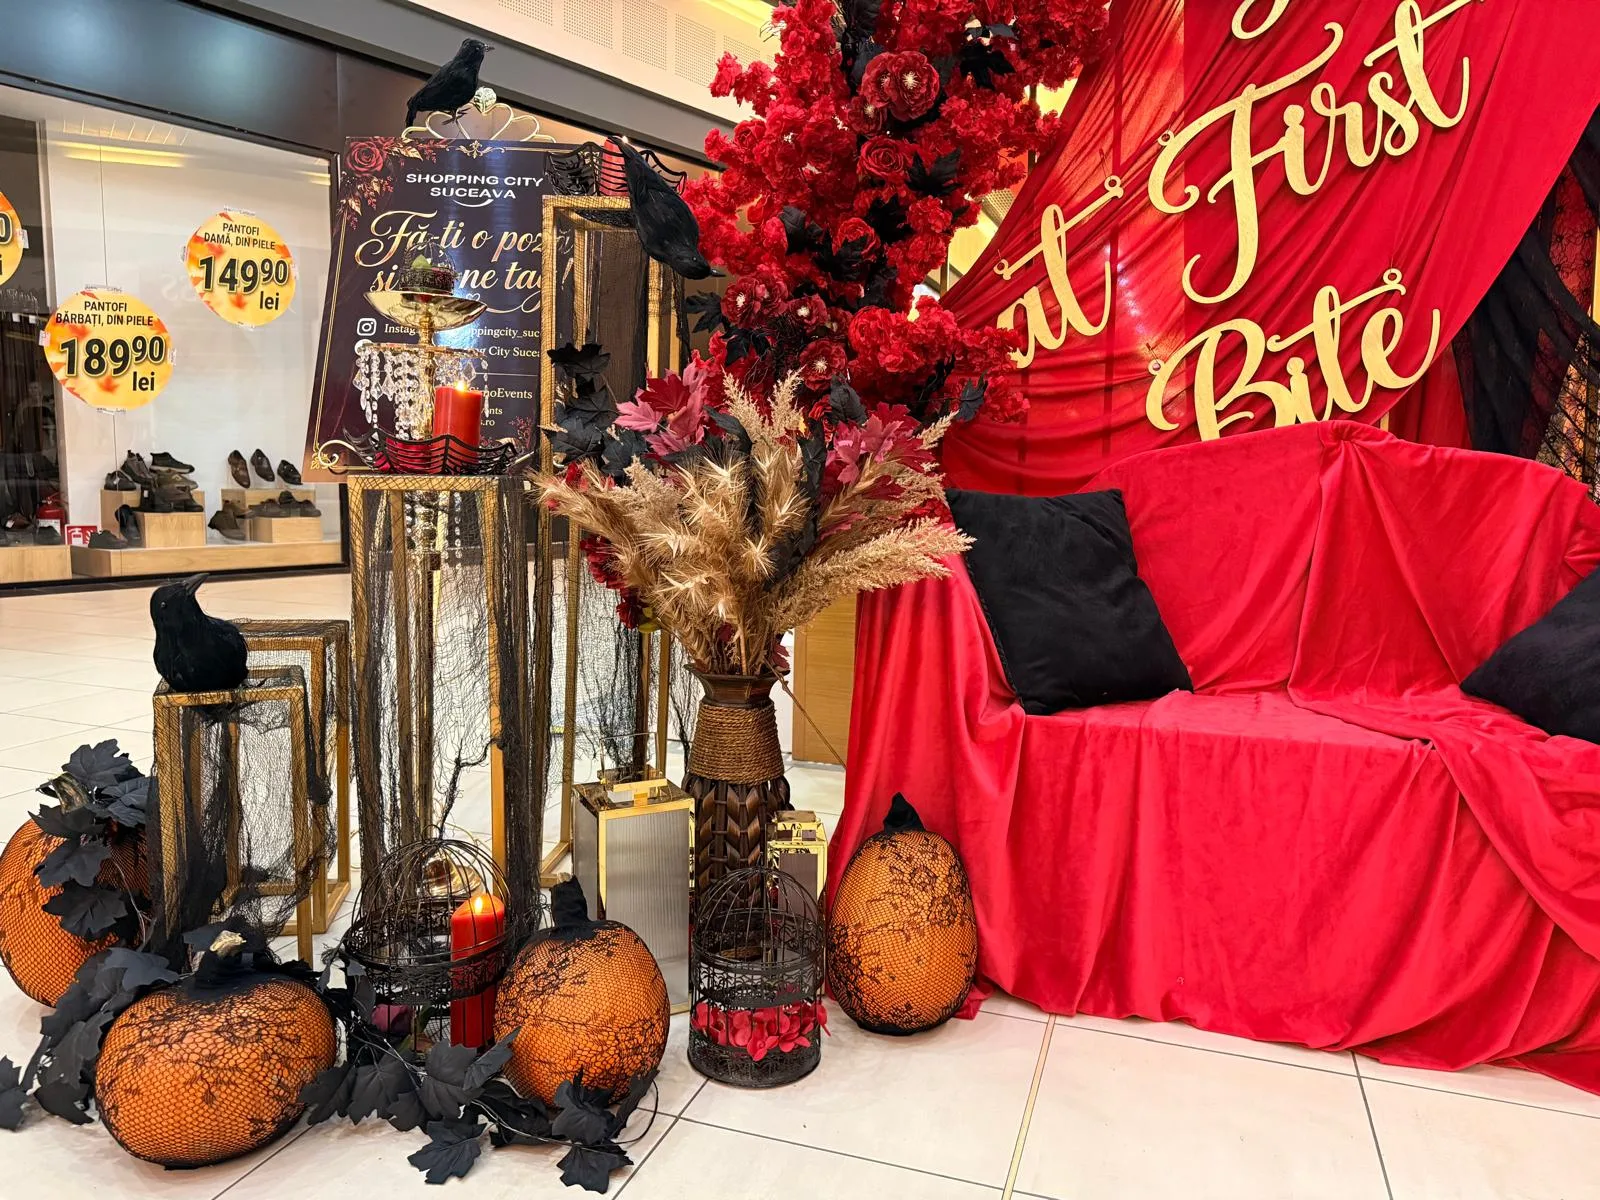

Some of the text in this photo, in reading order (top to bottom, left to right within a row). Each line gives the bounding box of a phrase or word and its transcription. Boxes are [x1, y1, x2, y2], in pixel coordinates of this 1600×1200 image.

[1148, 0, 1472, 303] First
[406, 174, 544, 187] SHOPPING CITY
[430, 187, 516, 199] SUCEAVA
[222, 222, 260, 236] PANTOFI
[204, 231, 276, 250] DAMĂ, DIN PIELE
[471, 231, 493, 249] o
[84, 300, 127, 313] PANTOFI
[258, 290, 280, 311] lei
[106, 313, 124, 325] DIN
[126, 315, 154, 327] PIELE
[384, 323, 416, 336] Instag
[488, 345, 511, 358] City
[1146, 268, 1441, 441] Bite
[132, 371, 155, 391] lei
